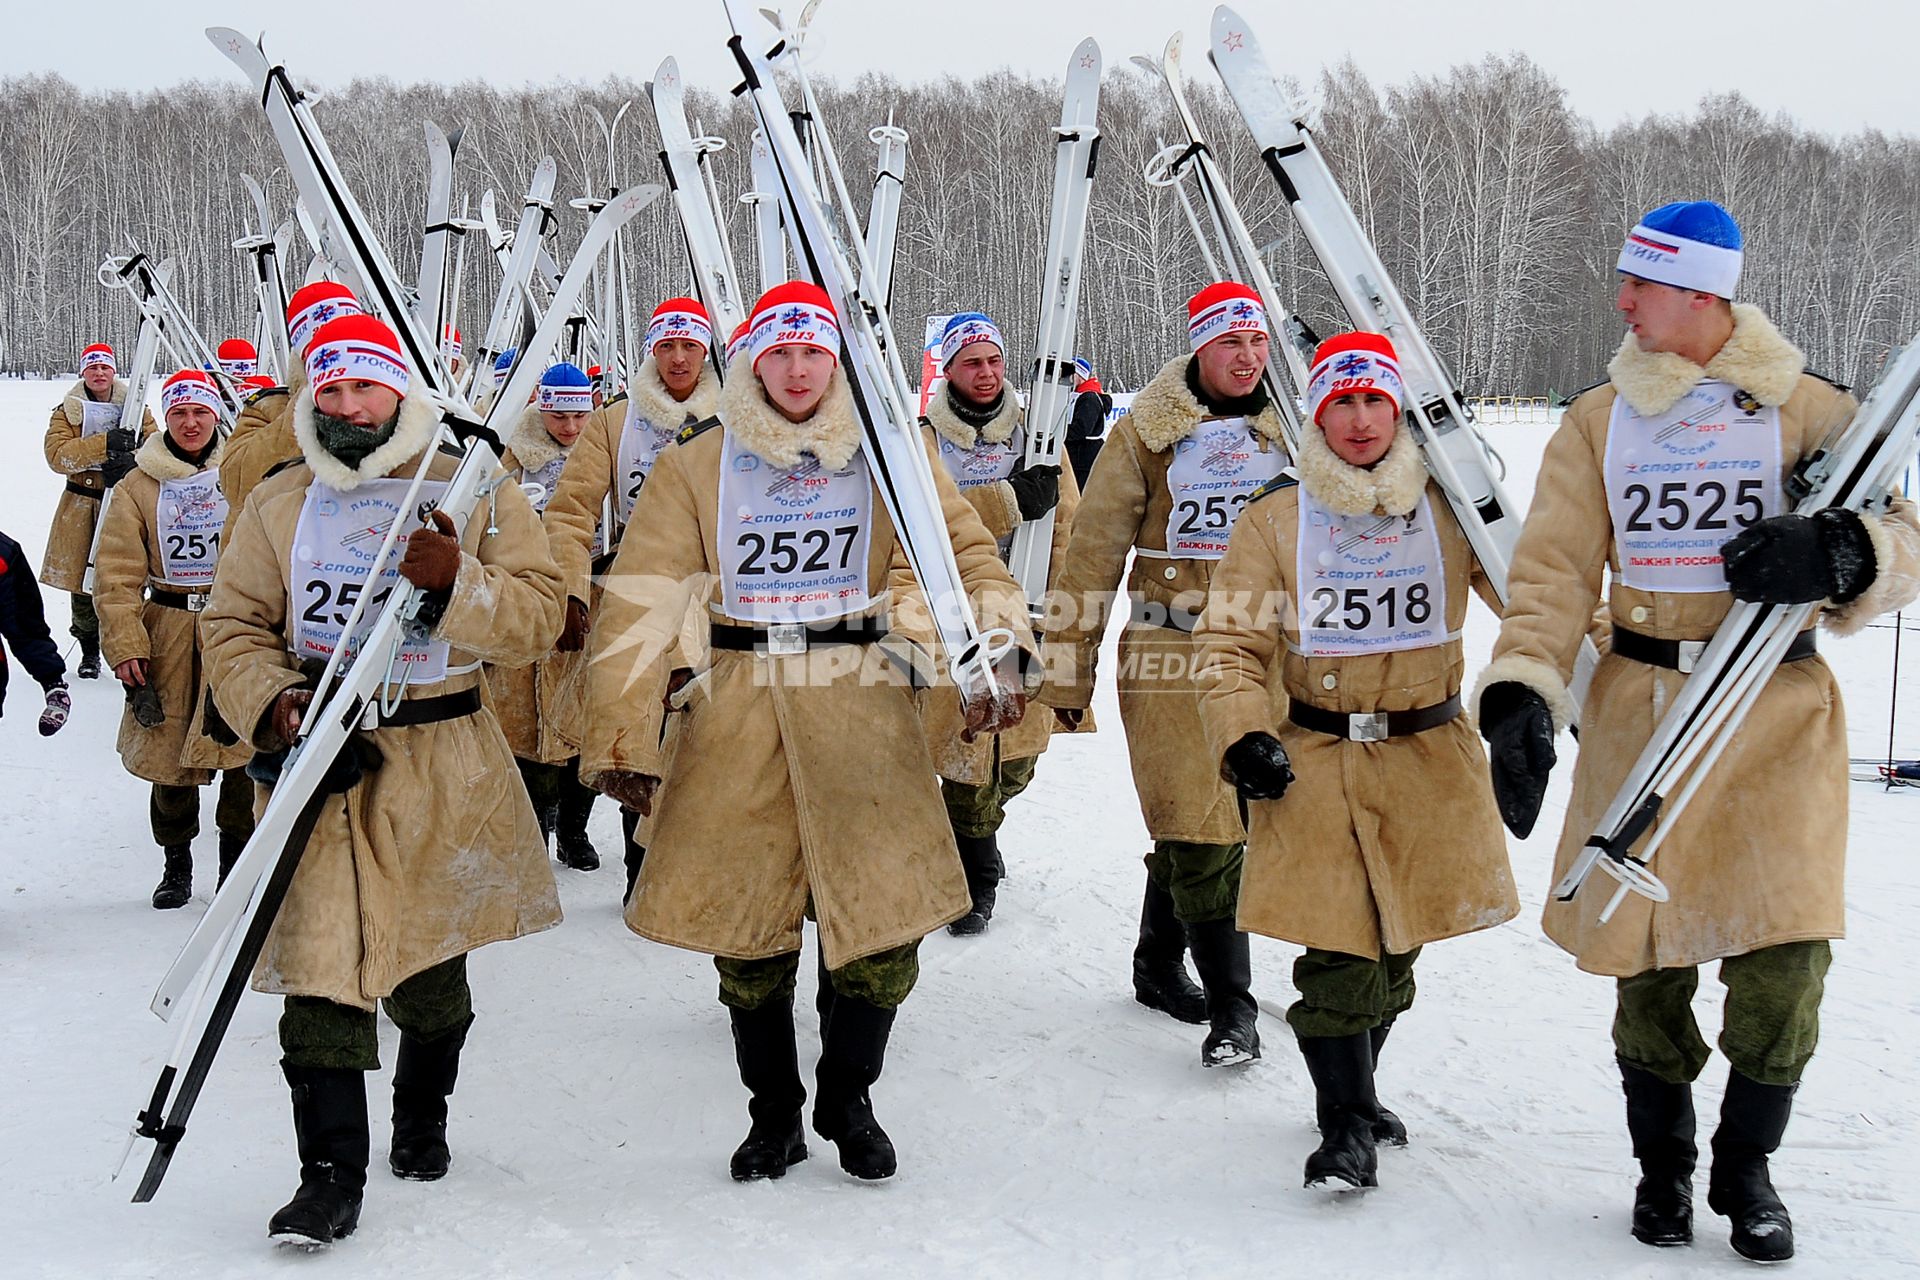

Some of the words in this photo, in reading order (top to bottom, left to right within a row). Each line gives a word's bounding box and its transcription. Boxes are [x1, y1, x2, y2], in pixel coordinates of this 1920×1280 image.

[1229, 320, 1259, 330] 2013
[775, 330, 815, 342] 2013
[961, 333, 990, 349] 2013
[354, 354, 408, 383] РОССИИ
[1331, 377, 1375, 393] 2013
[1203, 429, 1238, 441] ЛЫЖНЯ
[1696, 424, 1726, 432] 2013
[1661, 440, 1716, 456] РОССИИ
[968, 465, 998, 475] РОССИИ
[1207, 465, 1245, 477] РОССИИ
[803, 477, 829, 486] 2013
[350, 498, 400, 514] ЛЫЖНЯ
[774, 492, 822, 508] РОССИИ
[1623, 479, 1764, 532] 2525
[167, 532, 221, 560] 251
[1177, 541, 1213, 550] ЛЫЖНЯ
[1374, 535, 1399, 544] 2013
[736, 525, 860, 575] 2527
[1344, 551, 1392, 565] РОССИИ
[1629, 556, 1672, 566] ЛЫЖНЯ
[735, 578, 819, 591] Новосибирская
[821, 574, 858, 586] область
[739, 593, 781, 603] ЛЫЖНЯ
[784, 592, 829, 603] РОССИИ
[838, 588, 860, 597] 2013
[1311, 582, 1432, 631] 2518
[1310, 633, 1392, 646] Новосибирская
[1395, 629, 1432, 641] область
